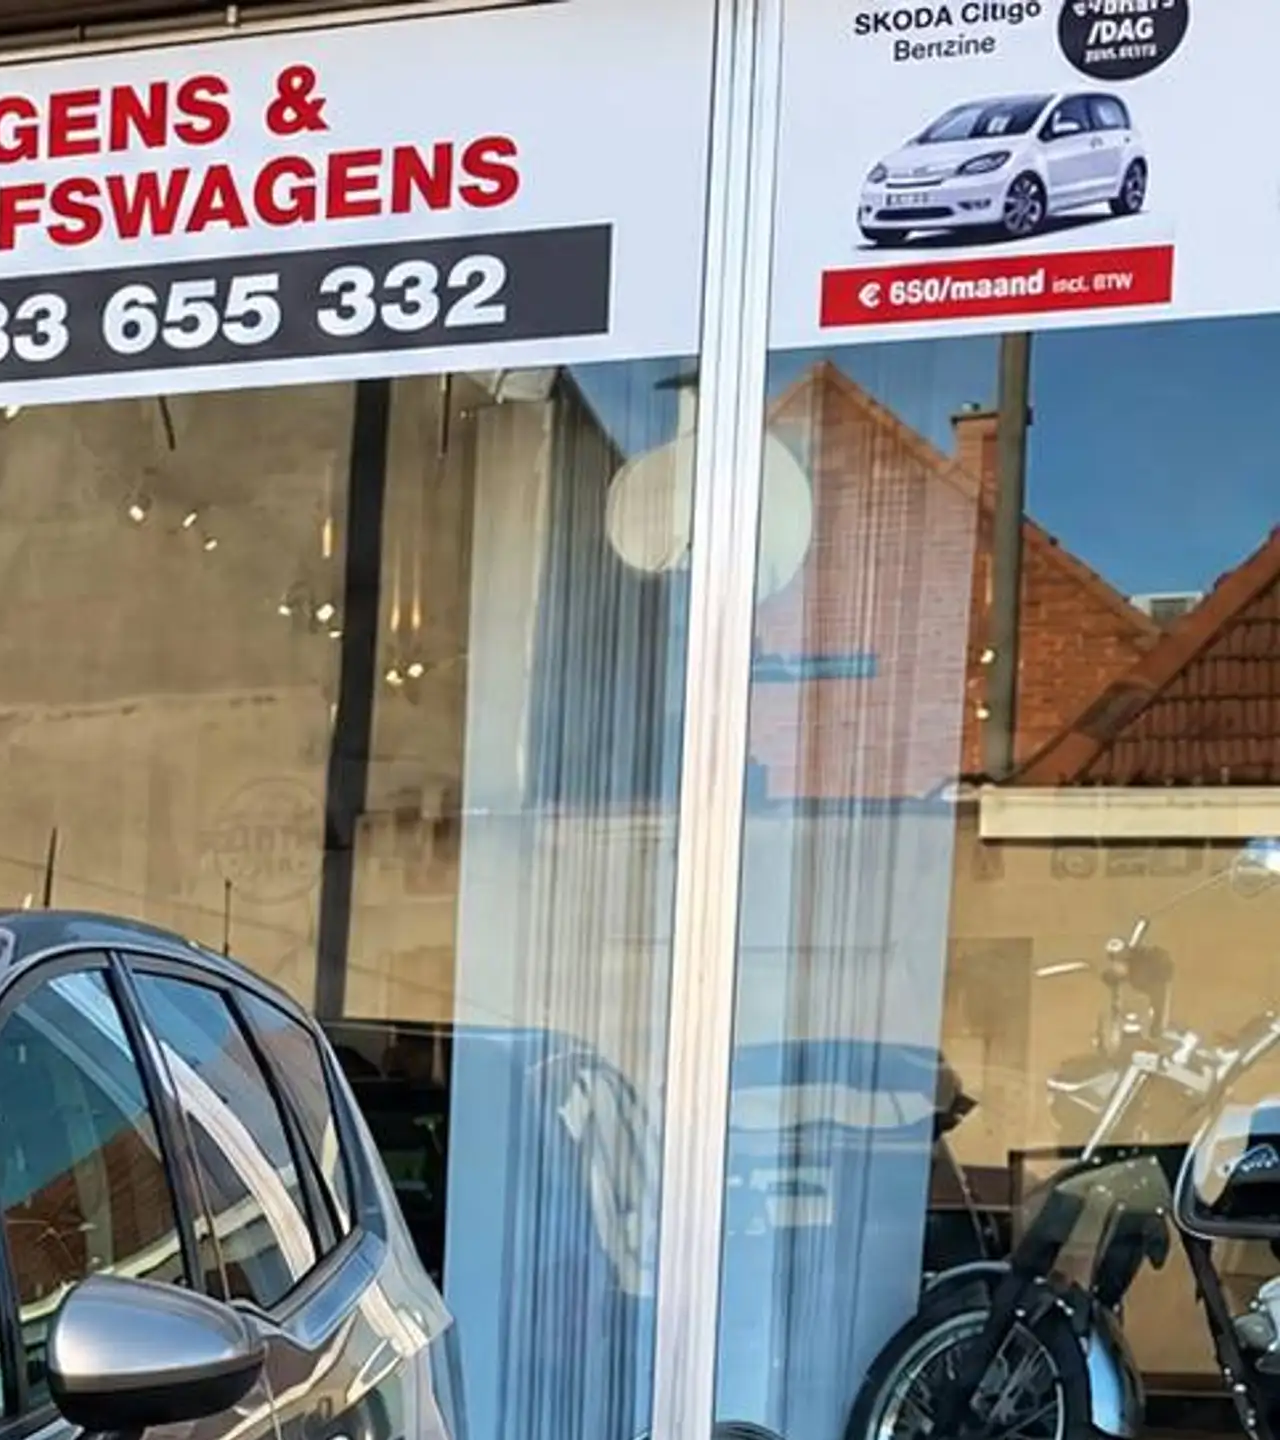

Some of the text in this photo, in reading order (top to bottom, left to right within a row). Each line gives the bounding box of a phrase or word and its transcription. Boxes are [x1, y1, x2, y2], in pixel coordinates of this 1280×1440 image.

[854, 8, 953, 37] SKODA
[1086, 16, 1154, 45] /DAG
[893, 34, 996, 61] Benzine
[266, 64, 329, 135] &
[102, 273, 281, 355] 655
[317, 254, 507, 336] 332
[857, 283, 881, 308] €
